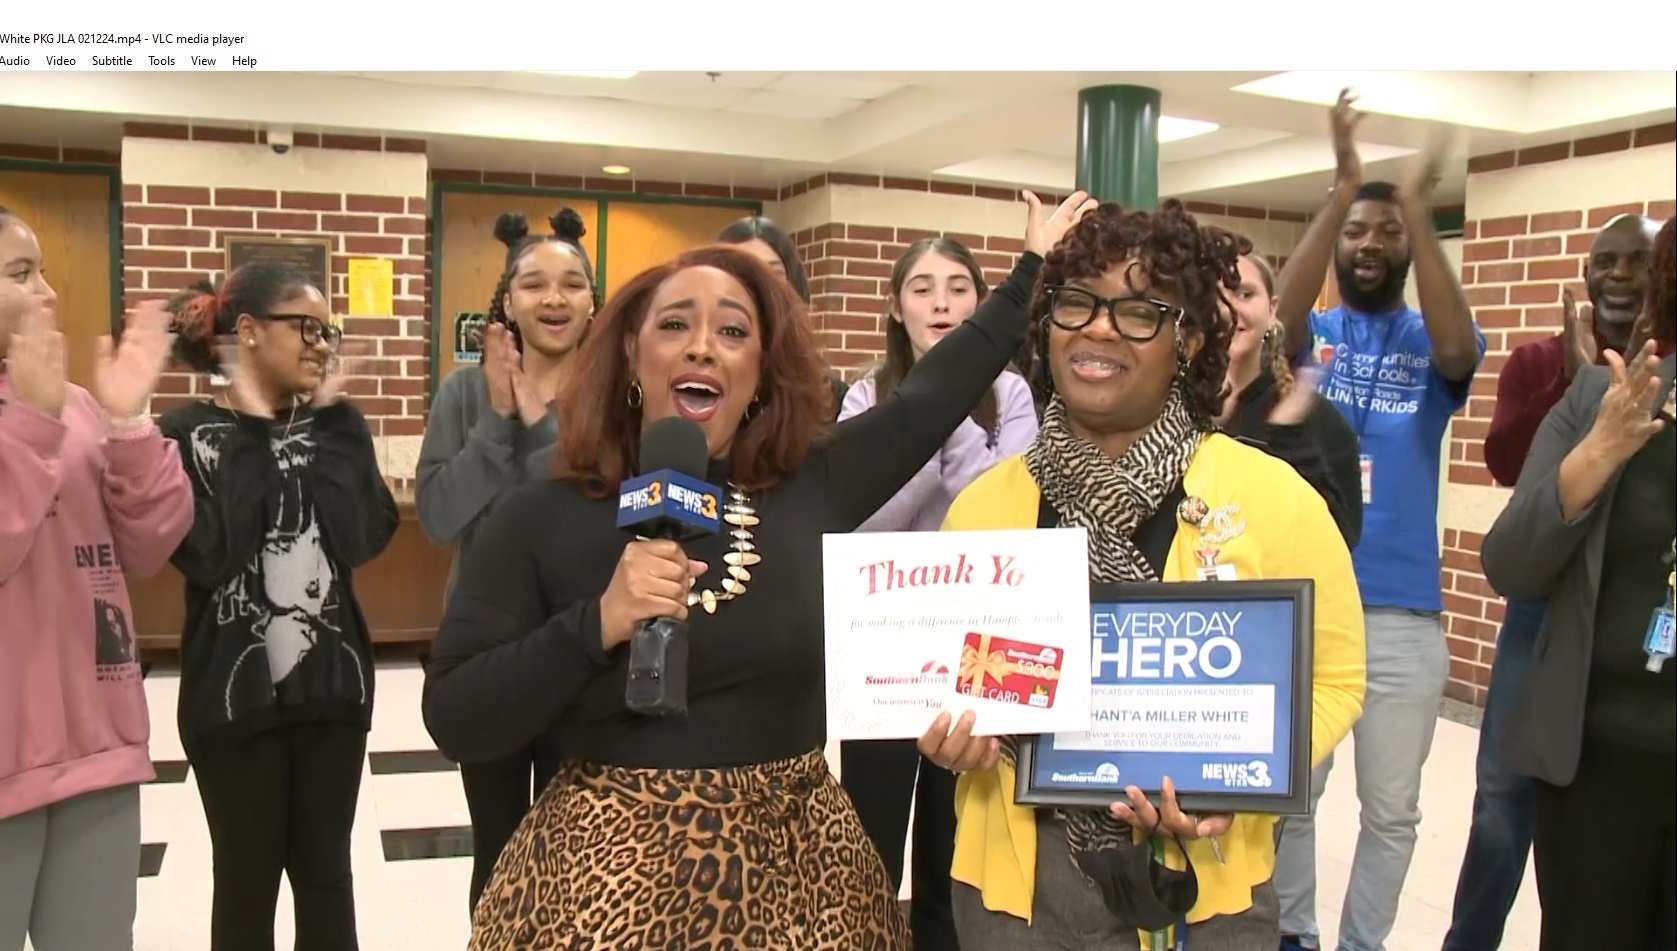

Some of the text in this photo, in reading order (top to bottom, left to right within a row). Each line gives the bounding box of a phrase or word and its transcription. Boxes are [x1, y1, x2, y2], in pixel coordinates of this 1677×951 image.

[620, 486, 649, 510] NEWS
[647, 480, 662, 507] 3
[667, 482, 703, 509] NEWS
[701, 492, 718, 519] 3
[859, 553, 1026, 597] Thank Yo
[1092, 611, 1243, 637] EVERYDAY
[1091, 636, 1242, 679] HERO
[988, 687, 1021, 705] CARD
[1091, 709, 1250, 723] HANT'A MILLER WHITE
[1202, 759, 1269, 788] NEWS 3
